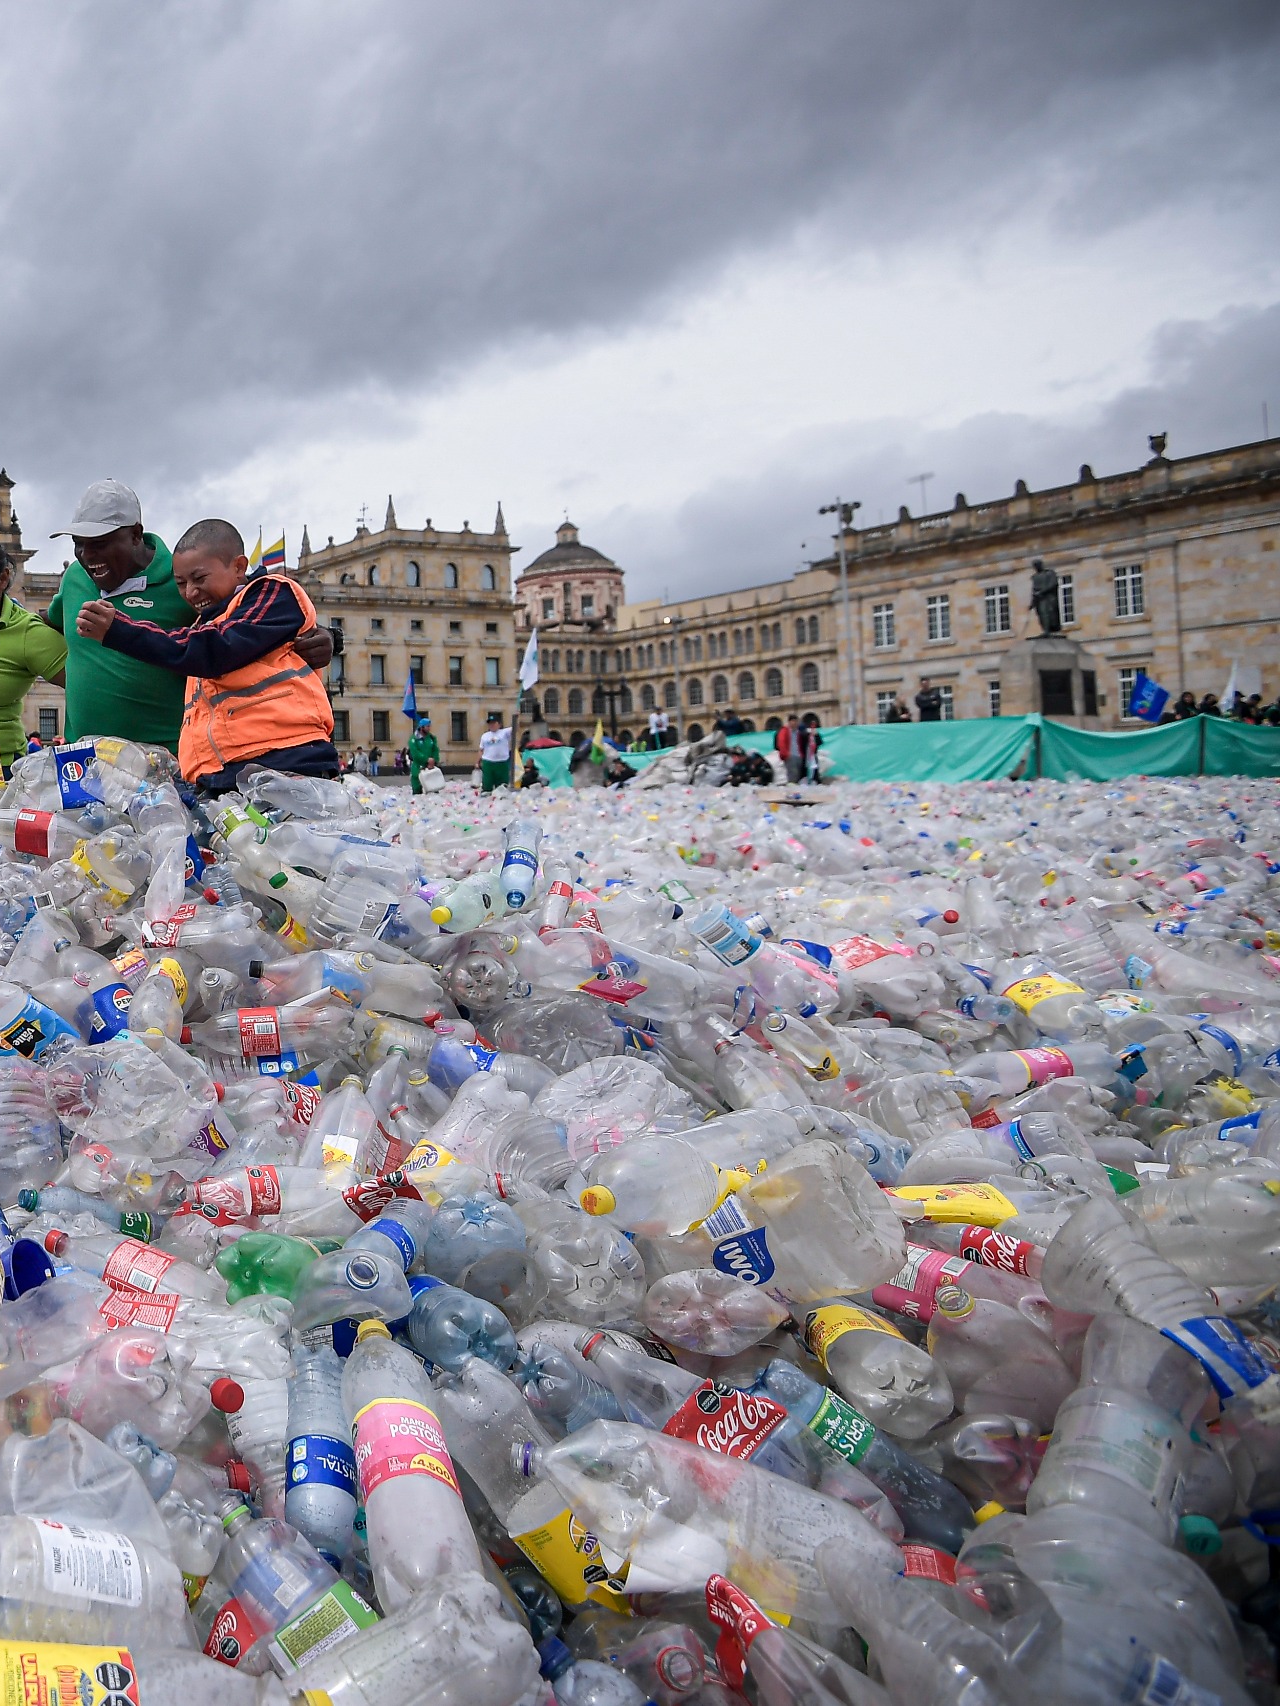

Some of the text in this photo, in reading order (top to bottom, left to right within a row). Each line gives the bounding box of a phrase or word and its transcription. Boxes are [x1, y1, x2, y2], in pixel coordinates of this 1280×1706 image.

[14, 1027, 35, 1047] Valle
[755, 1412, 784, 1441] ORIGINAL
[413, 1459, 451, 1480] $4.500
[53, 1547, 61, 1574] VINAGRE
[518, 1539, 547, 1573] RECICLAME
